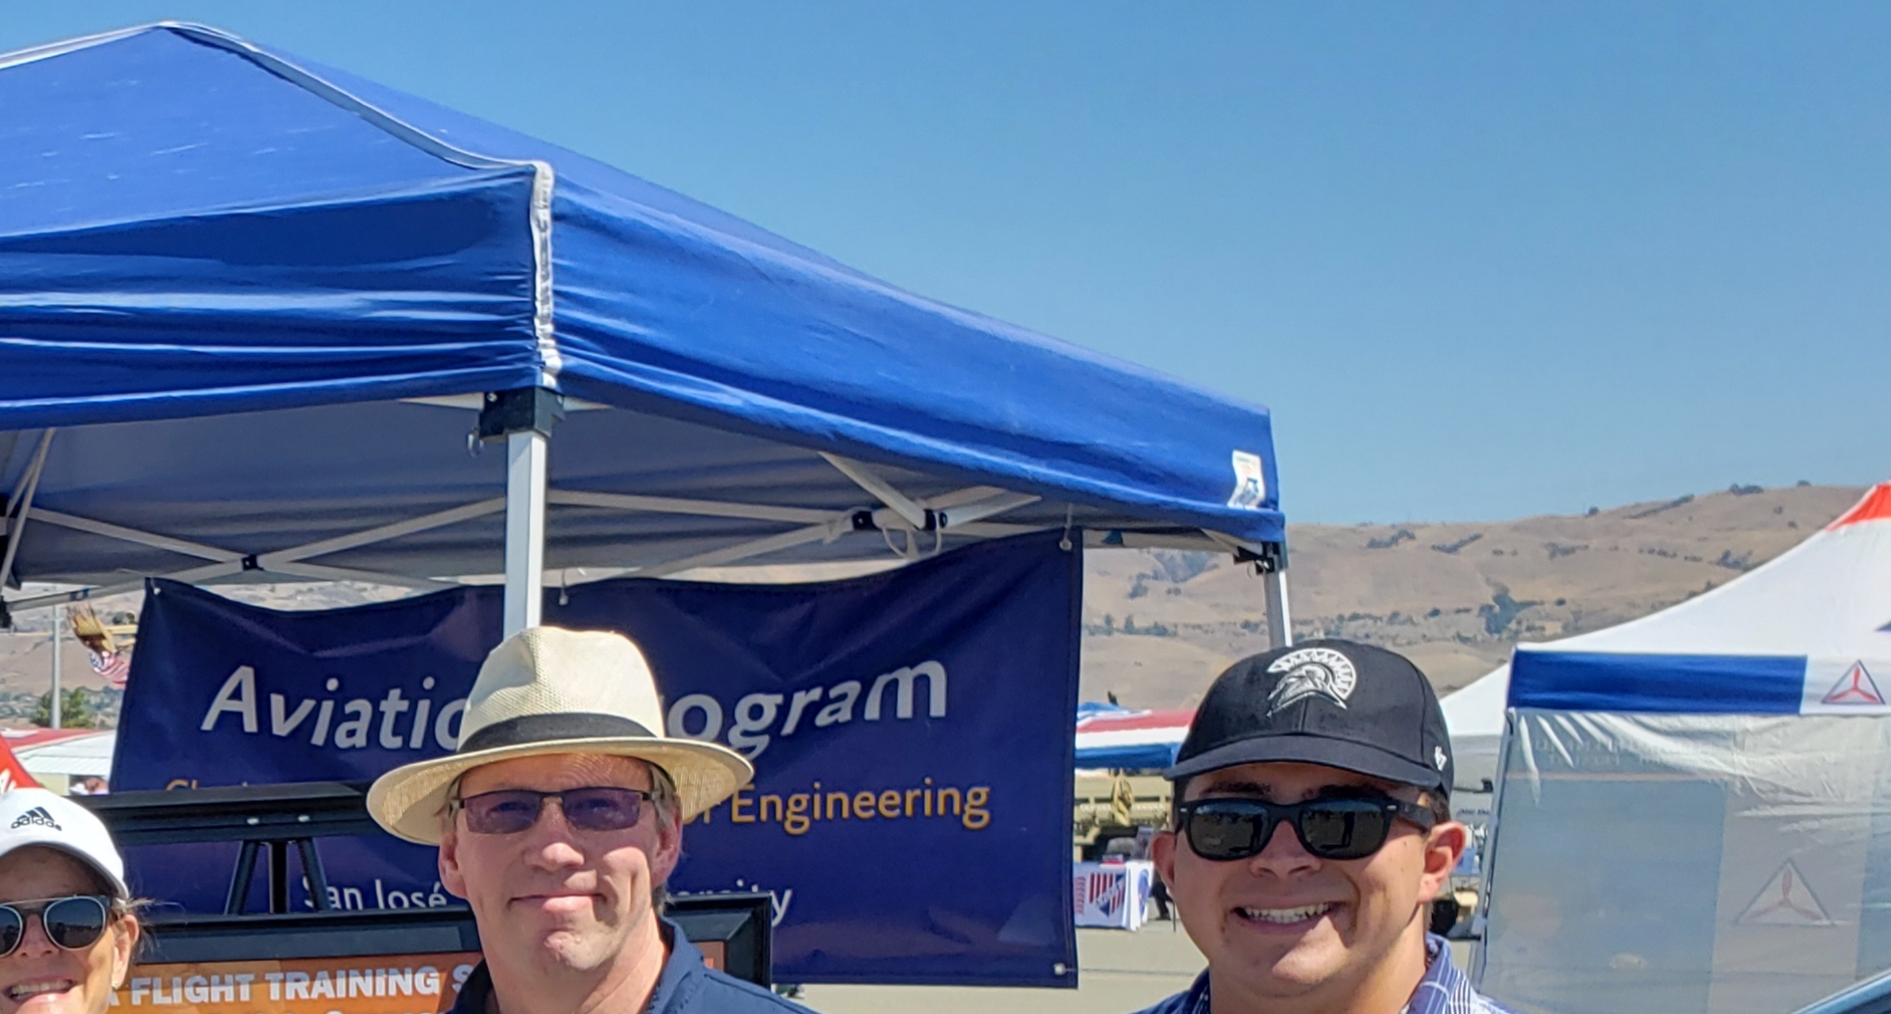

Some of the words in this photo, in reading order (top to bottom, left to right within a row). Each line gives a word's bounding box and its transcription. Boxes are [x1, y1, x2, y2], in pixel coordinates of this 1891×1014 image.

[200, 665, 466, 750] Aviatio
[665, 660, 946, 760] ogram
[11, 816, 62, 831] adidas
[731, 777, 991, 835] Engineering
[131, 973, 255, 1006] FLIGHT
[265, 964, 440, 1001] TRAINING
